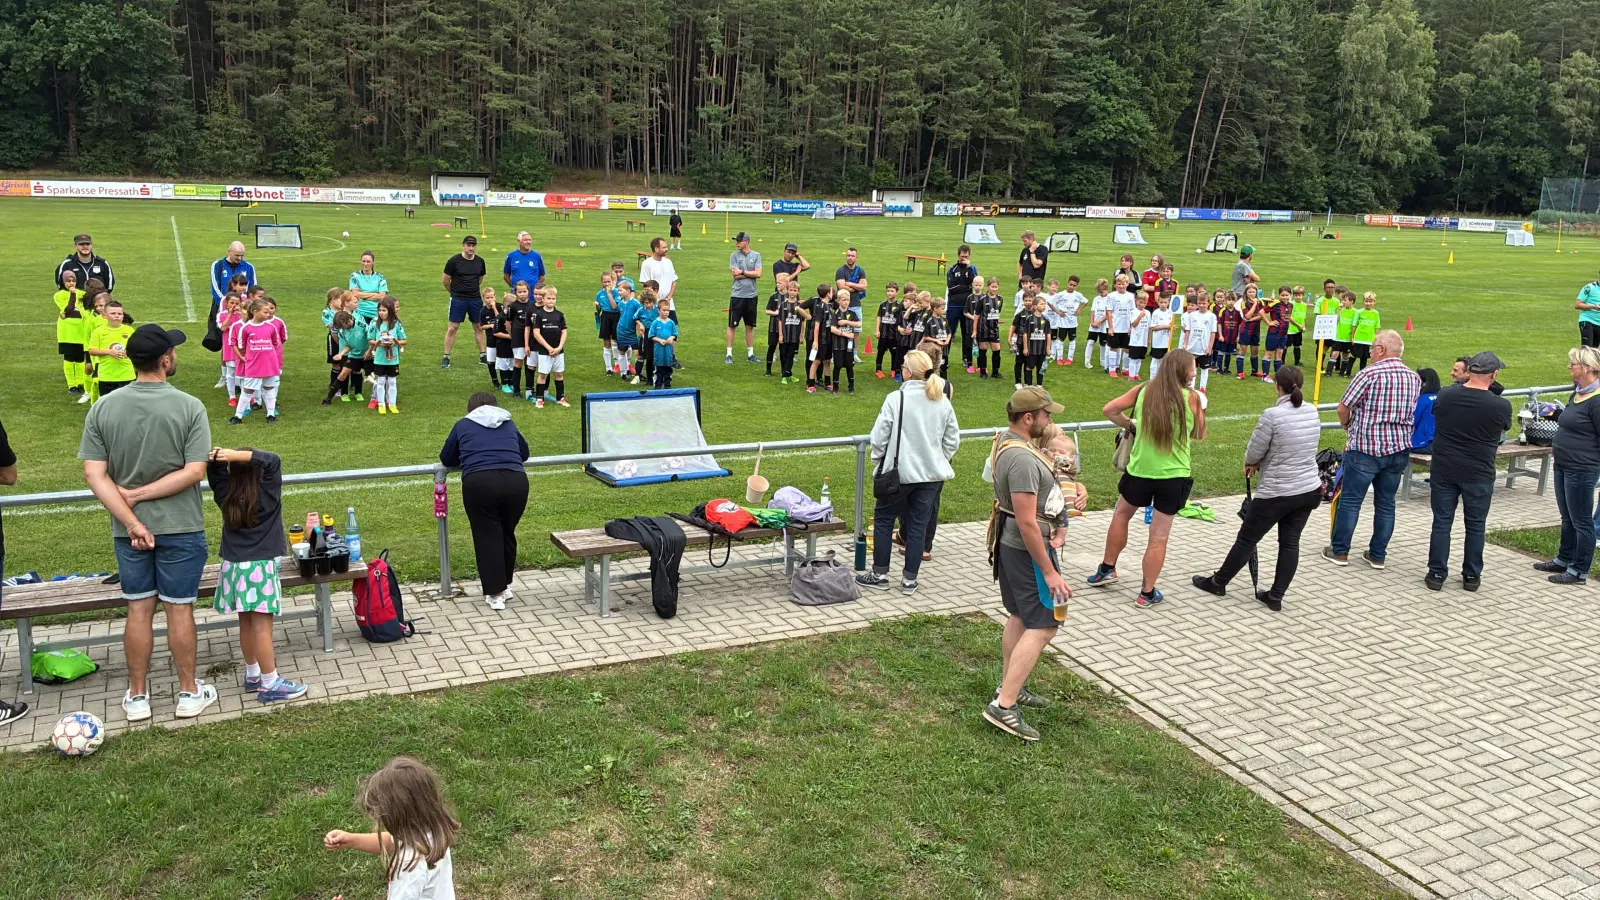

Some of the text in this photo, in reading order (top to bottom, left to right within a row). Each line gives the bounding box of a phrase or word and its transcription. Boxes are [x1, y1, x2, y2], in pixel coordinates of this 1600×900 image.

[47, 185, 96, 196] Sparkasse
[99, 185, 139, 196] Pressath
[1087, 206, 1106, 216] Paper
[1109, 207, 1126, 217] Shop
